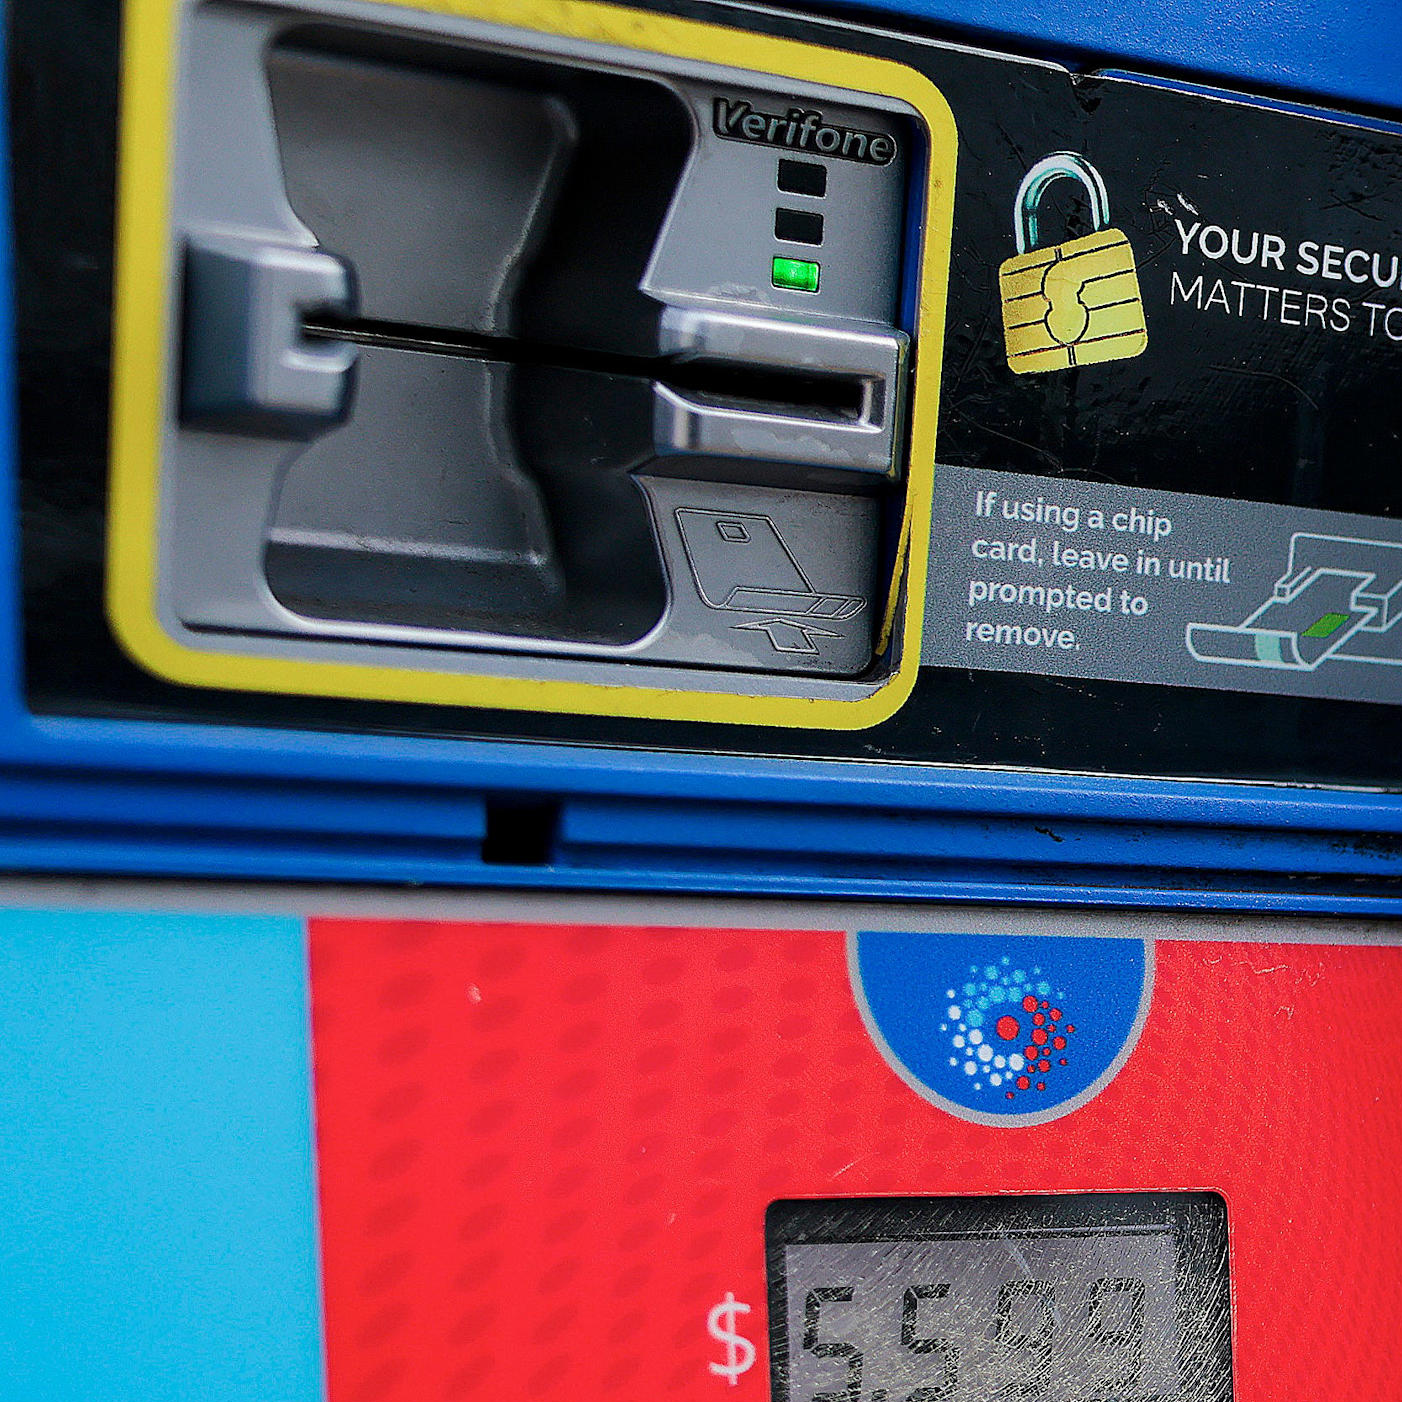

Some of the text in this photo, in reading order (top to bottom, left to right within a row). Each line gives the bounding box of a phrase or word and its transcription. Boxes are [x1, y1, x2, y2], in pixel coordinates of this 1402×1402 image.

[714, 97, 895, 166] Verifone
[1175, 218, 1286, 271] YOUR
[1170, 271, 1351, 334] MATTERS
[975, 487, 1173, 540] If using a chip
[971, 534, 1231, 585] card, leave in until
[968, 574, 1148, 620] prompted to
[965, 617, 1082, 657] remove.
[707, 1292, 757, 1386] $
